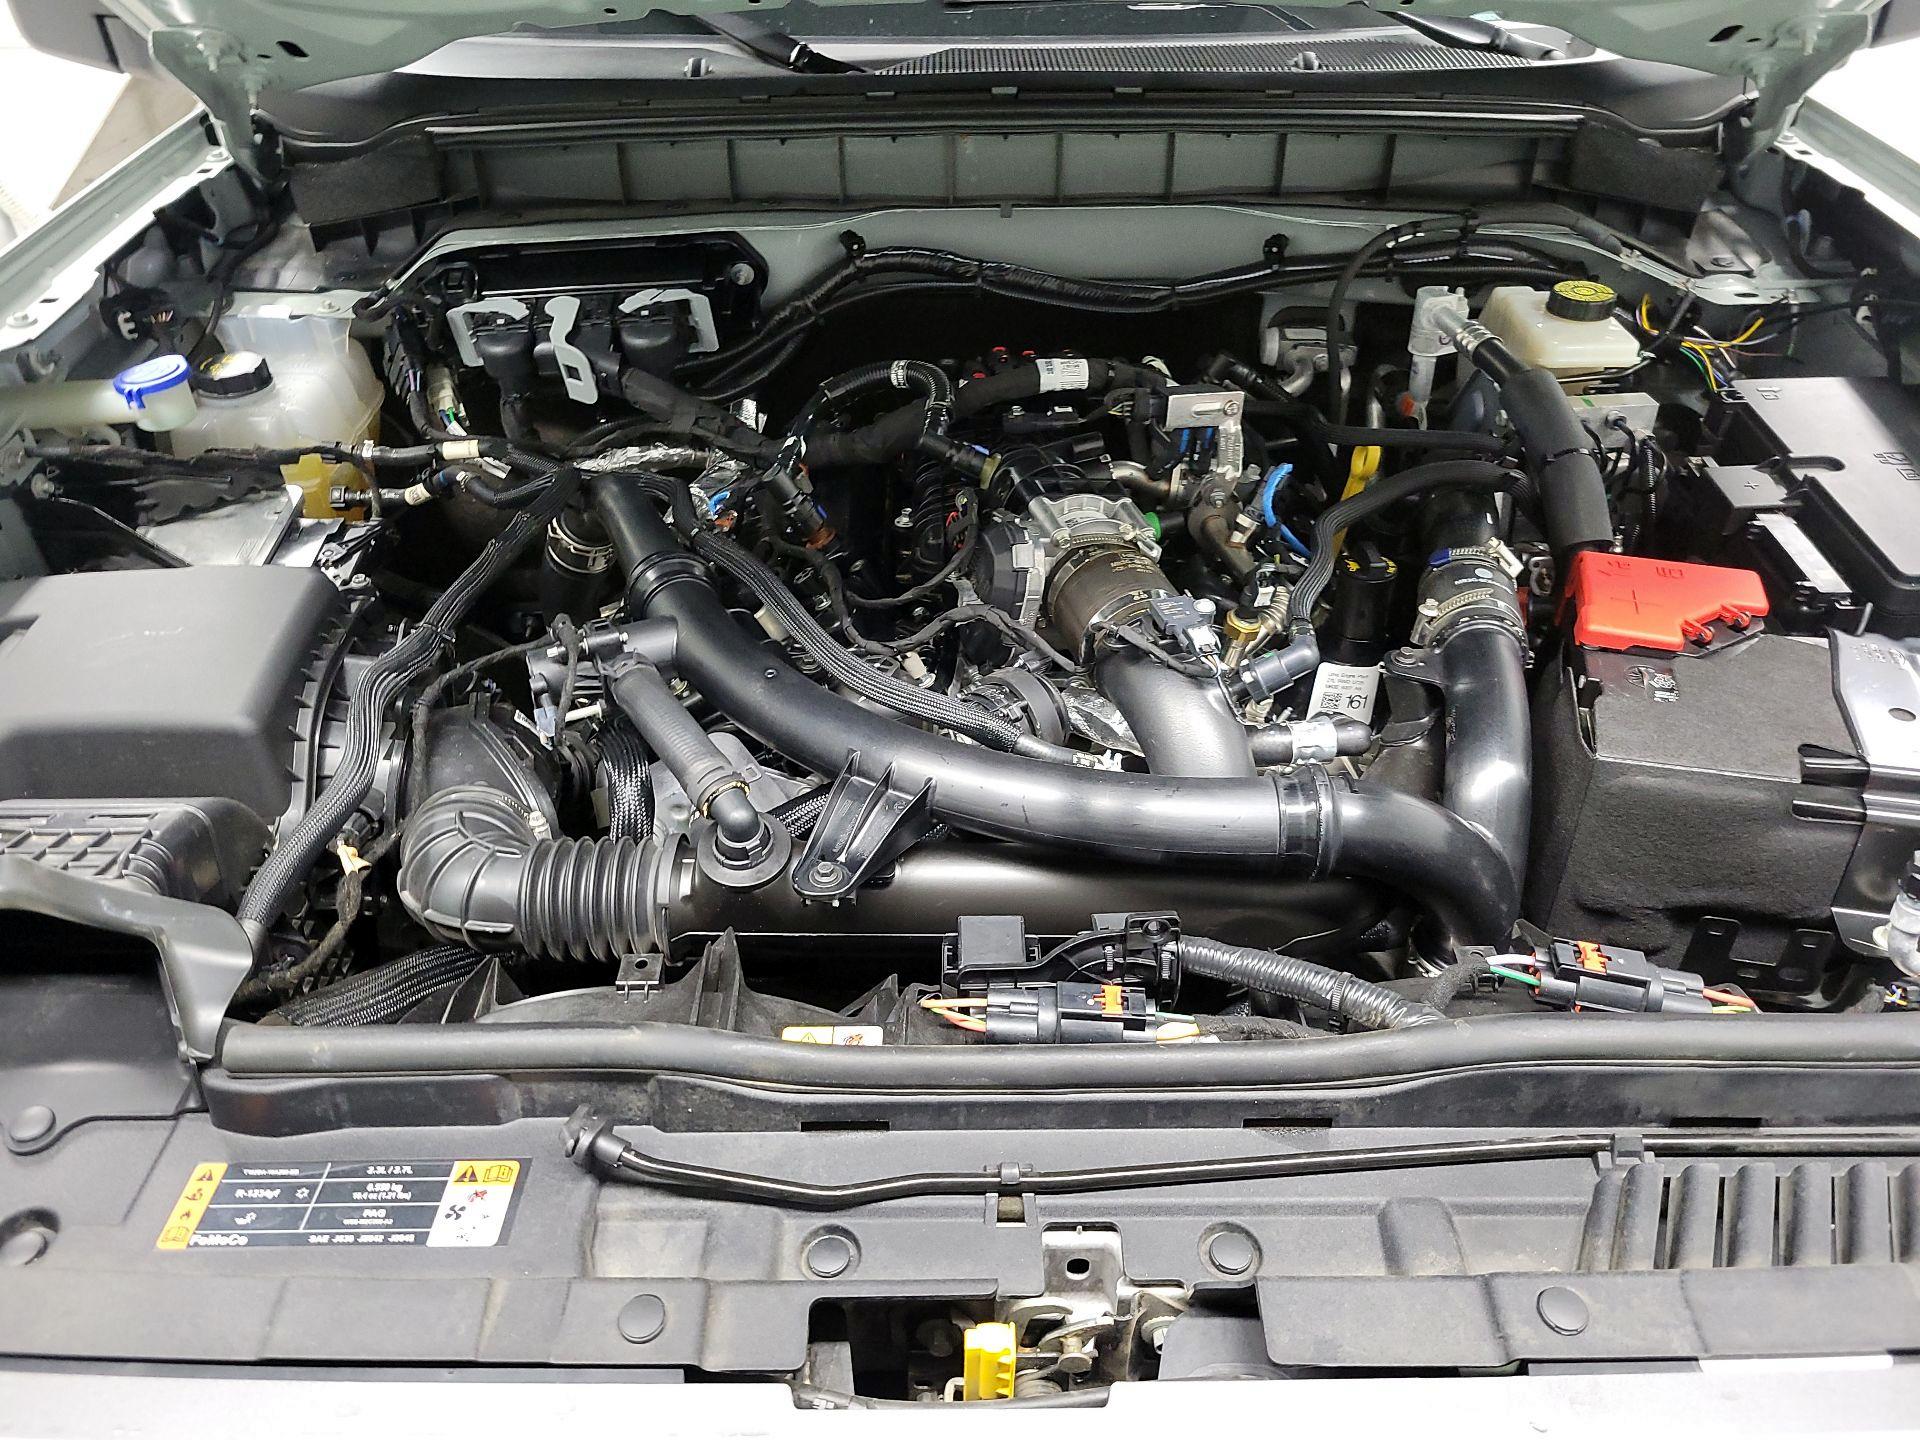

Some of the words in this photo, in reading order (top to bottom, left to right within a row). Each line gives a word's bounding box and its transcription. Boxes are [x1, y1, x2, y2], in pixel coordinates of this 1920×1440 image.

[1345, 694, 1368, 709] 161
[362, 1208, 387, 1218] PAG
[189, 1233, 249, 1246] FoMoCo
